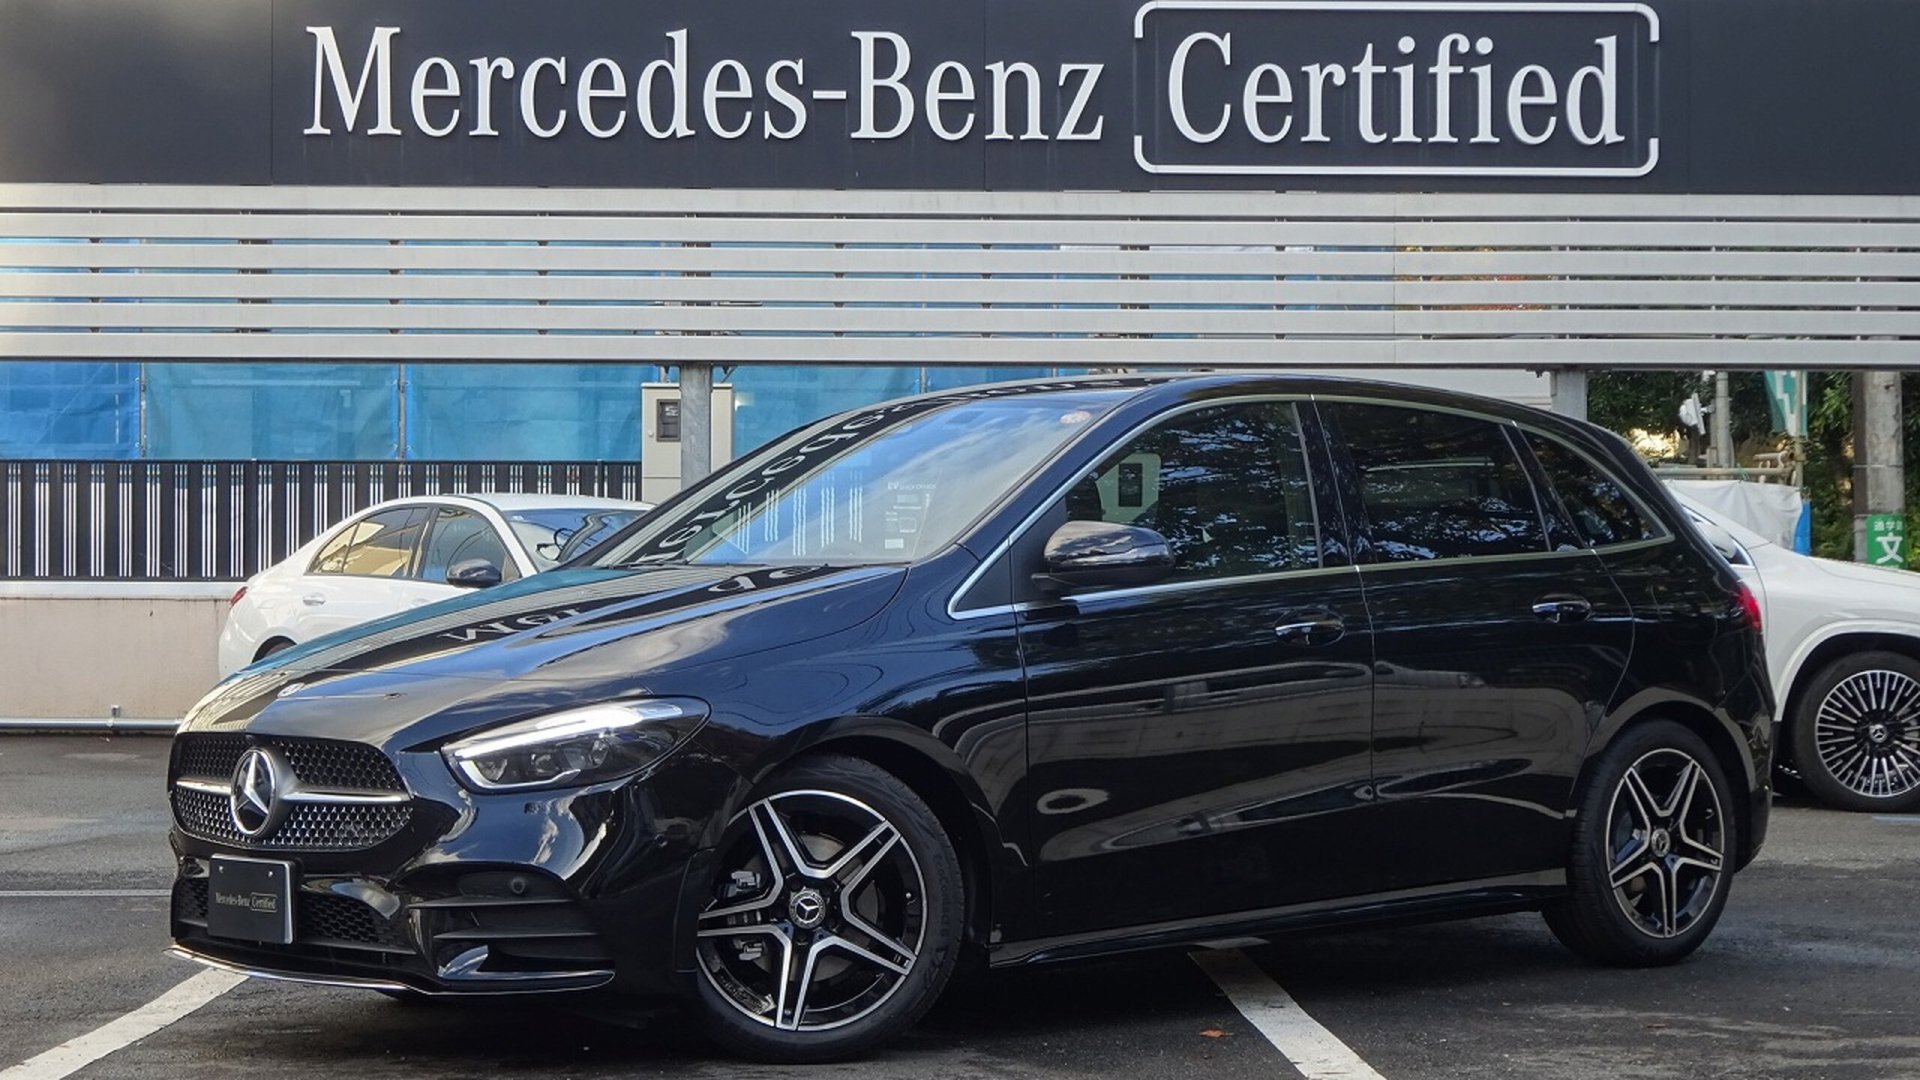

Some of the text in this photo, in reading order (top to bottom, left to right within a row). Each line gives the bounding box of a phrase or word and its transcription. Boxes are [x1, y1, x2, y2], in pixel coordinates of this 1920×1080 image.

[303, 26, 1626, 146] Mercedes-Benz Certified
[1875, 532, 1904, 564] 文
